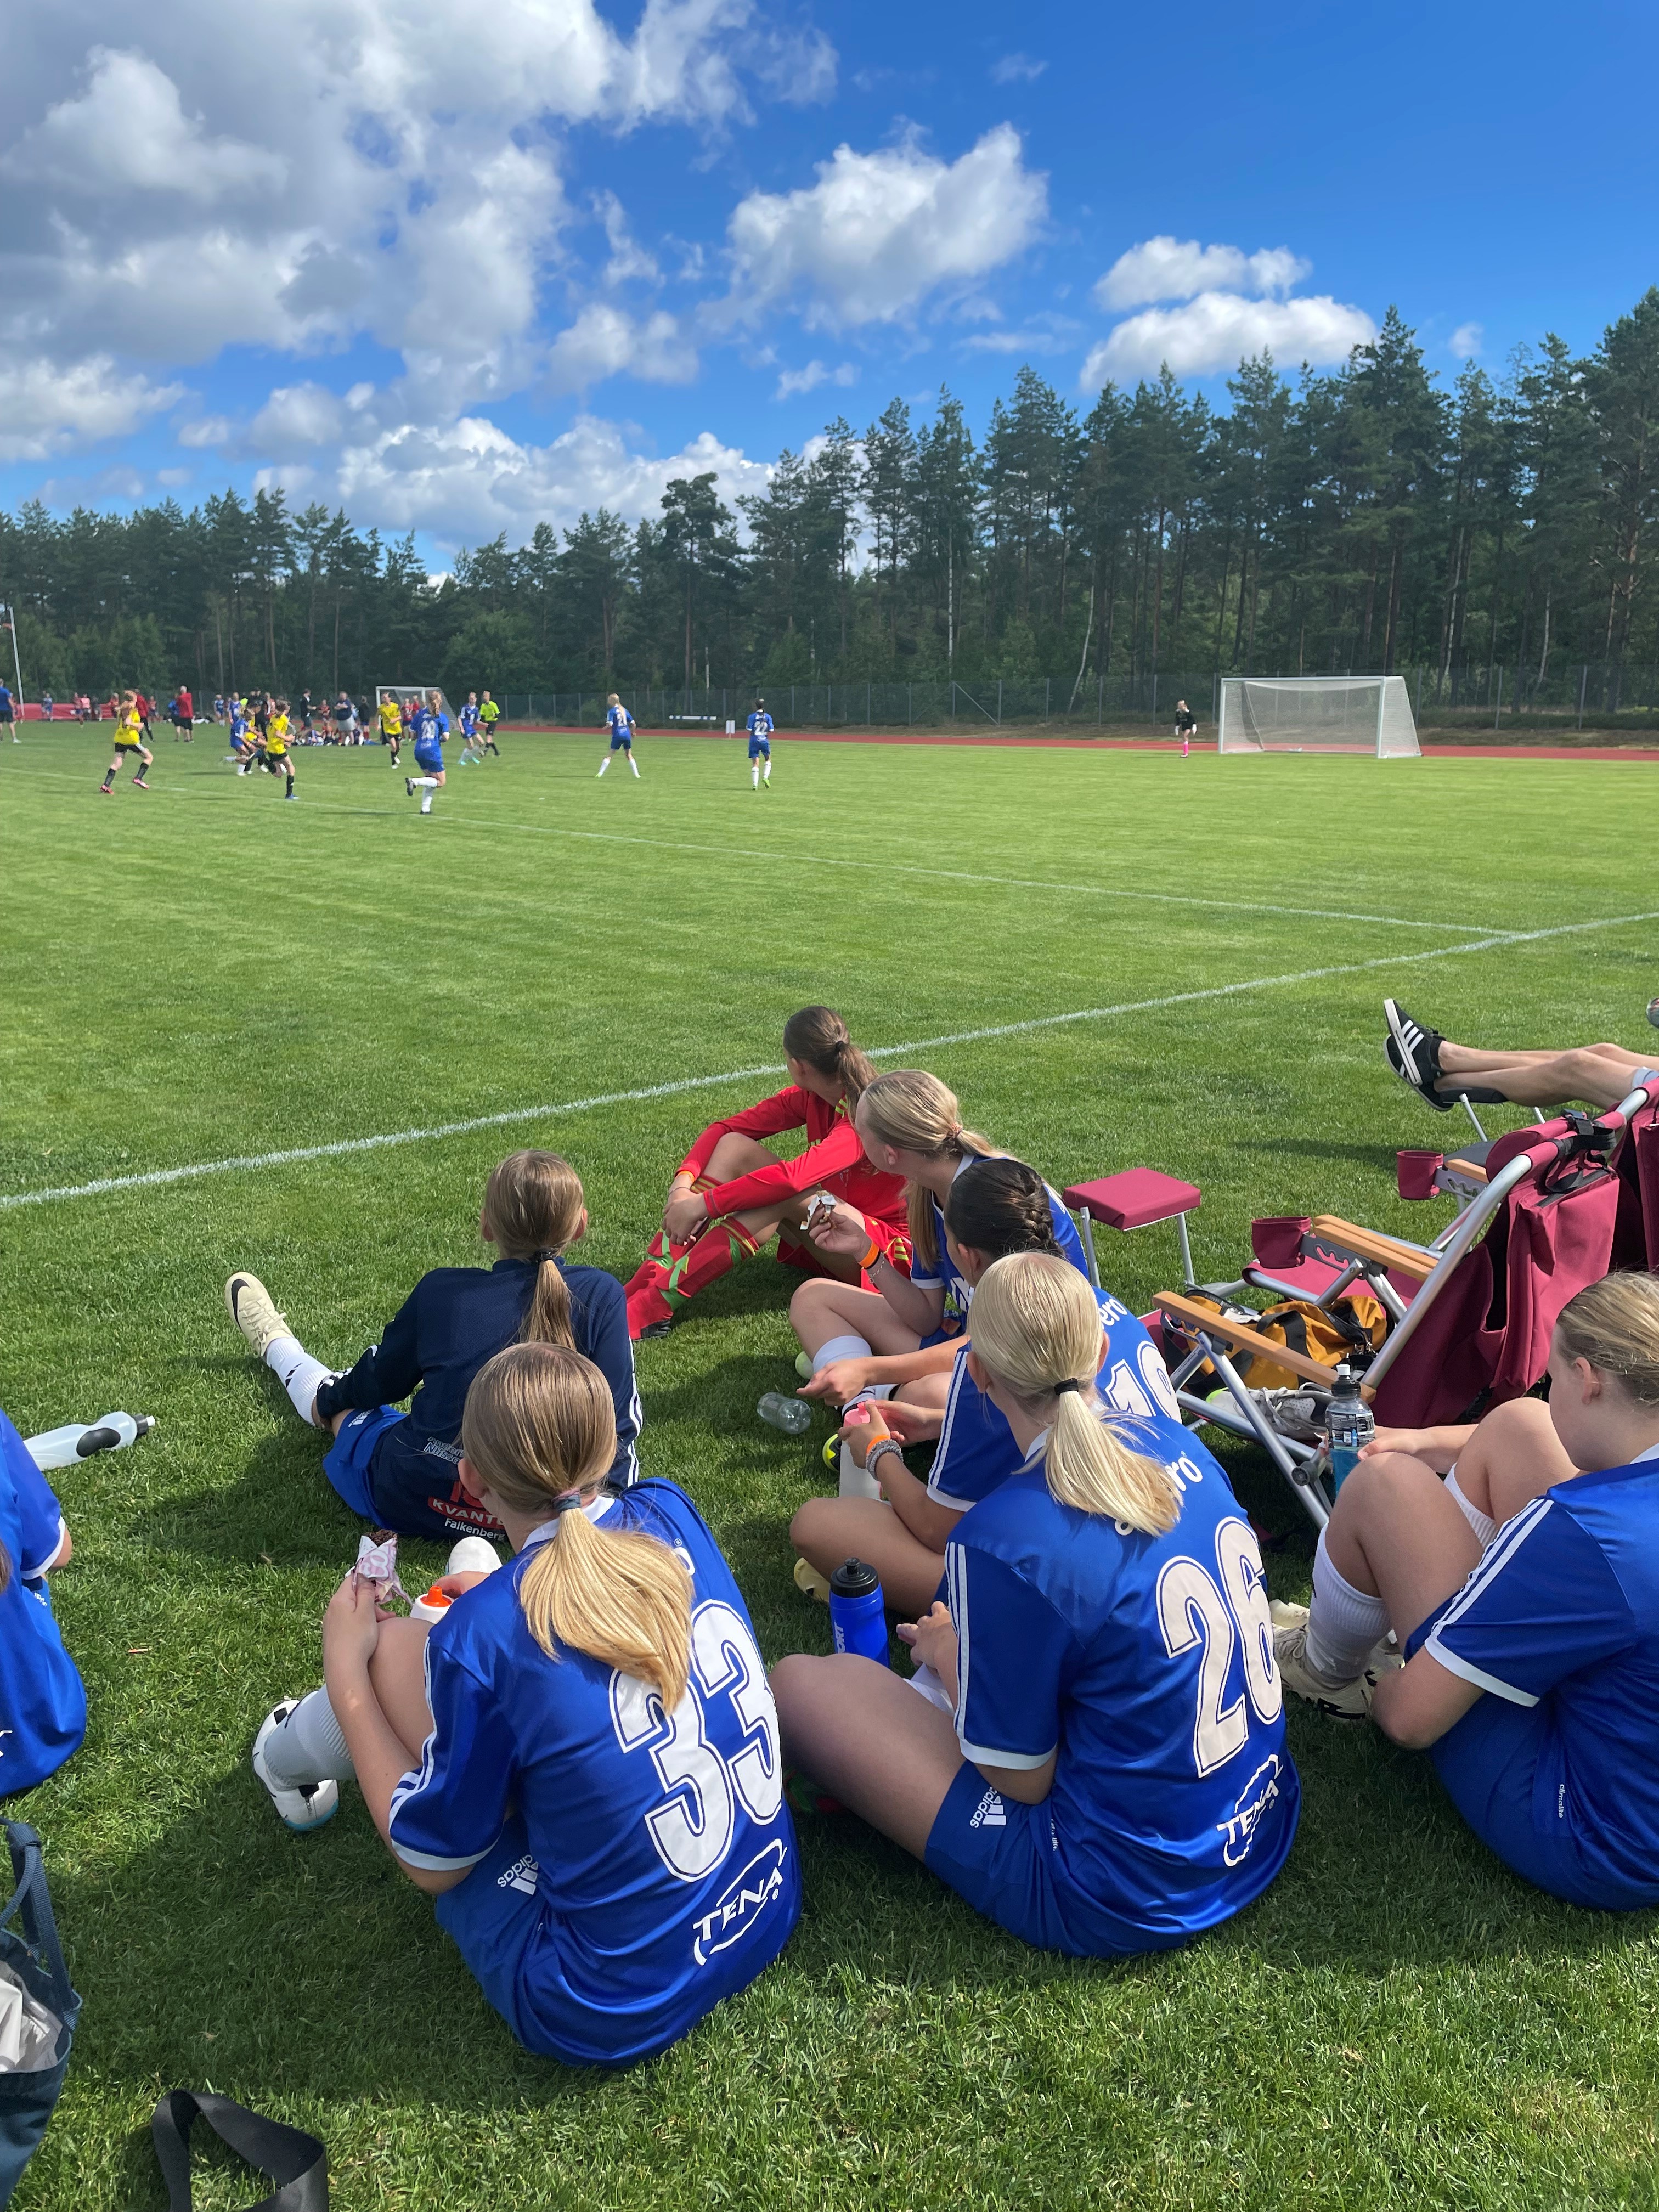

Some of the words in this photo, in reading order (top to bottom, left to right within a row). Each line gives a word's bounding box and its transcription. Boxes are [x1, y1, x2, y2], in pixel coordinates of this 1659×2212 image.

[423, 1442, 462, 1465] Nilsso
[1156, 1516, 1282, 1778] 26
[608, 1599, 782, 1882] 33
[497, 1854, 533, 1888] didas
[692, 1866, 783, 1942] TENA
